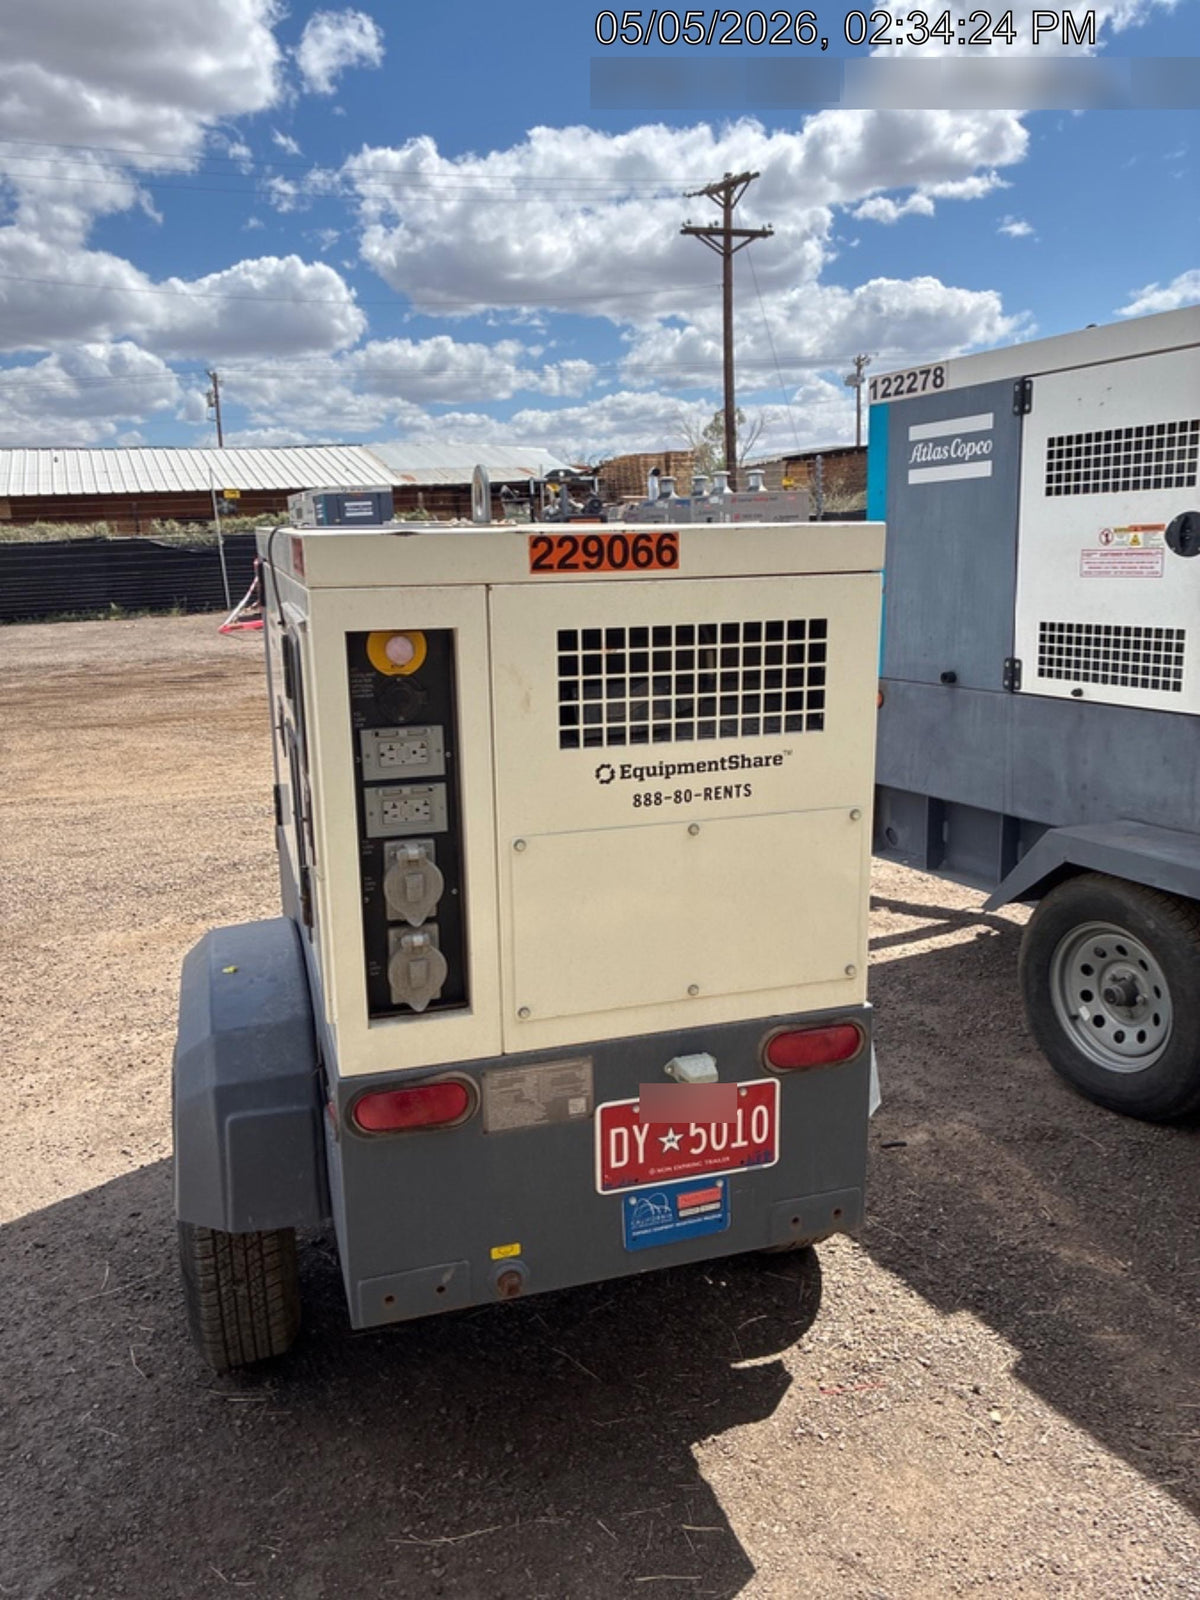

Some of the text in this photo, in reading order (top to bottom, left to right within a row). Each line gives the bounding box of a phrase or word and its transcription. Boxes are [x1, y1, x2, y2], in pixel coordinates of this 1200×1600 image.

[869, 366, 945, 400] 122278
[909, 438, 993, 464] Atlas Copco
[531, 533, 678, 570] 229066
[632, 783, 752, 808] 888-80-RENTS
[610, 1105, 769, 1168] DY 5010
